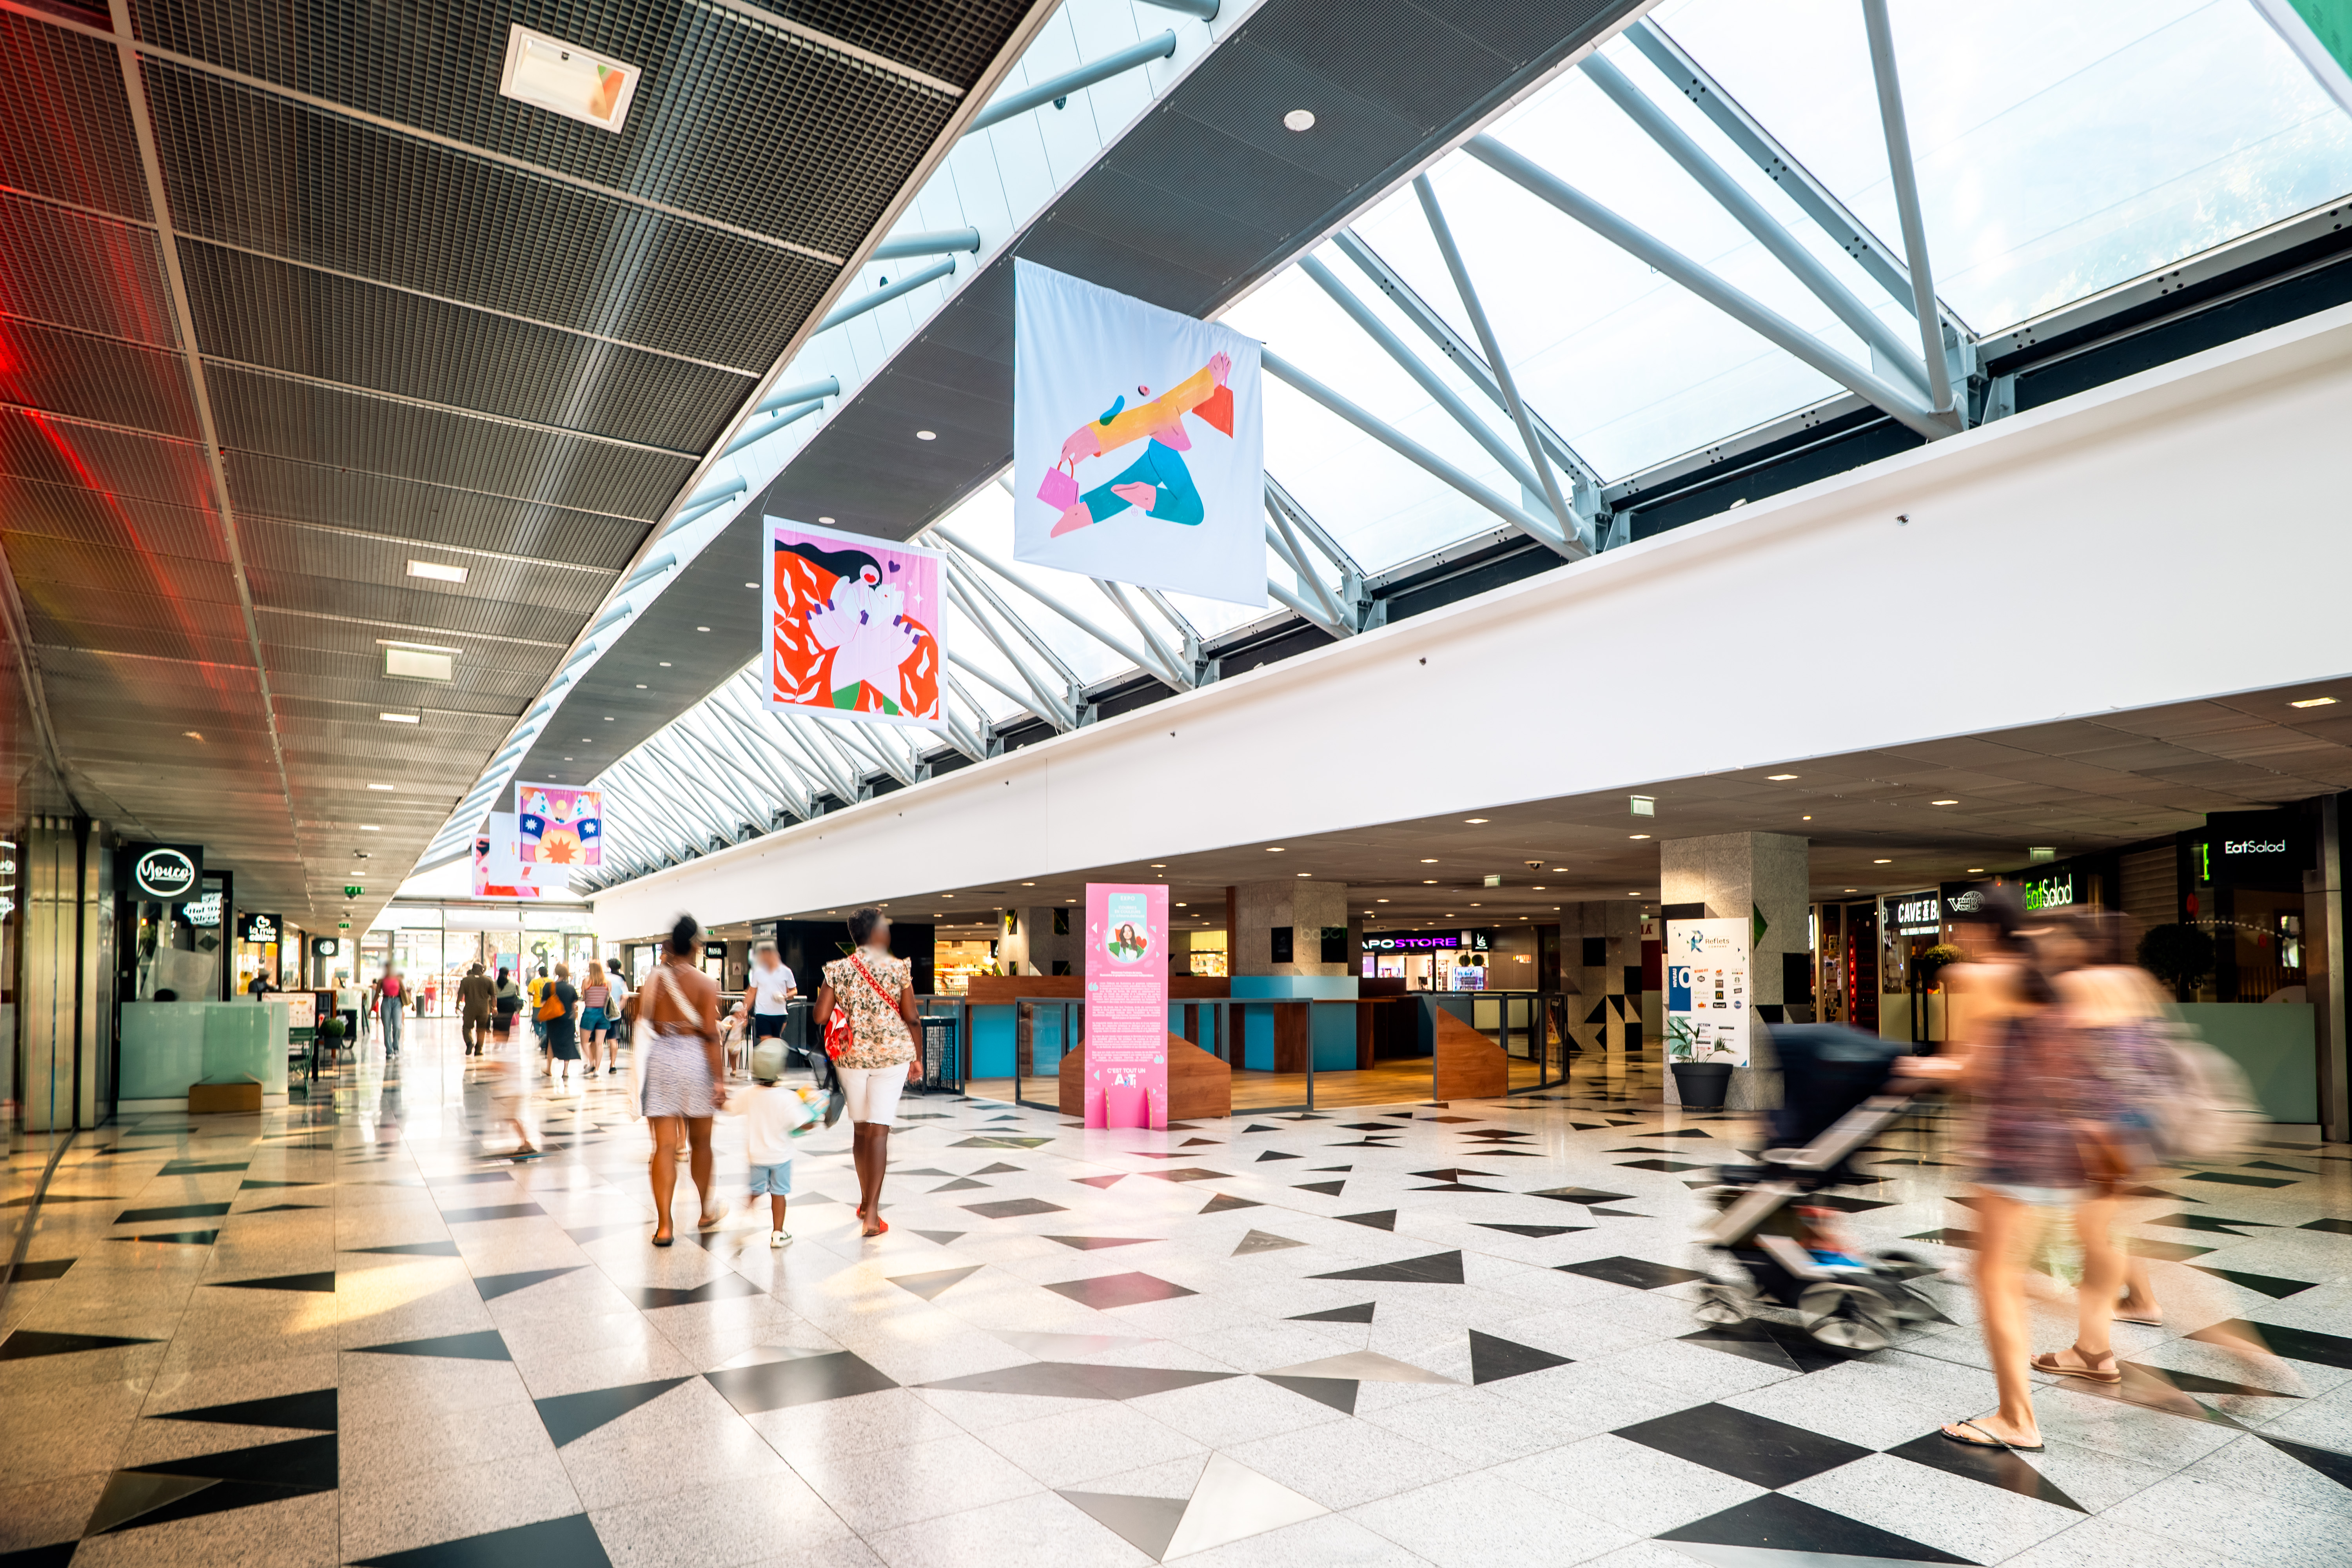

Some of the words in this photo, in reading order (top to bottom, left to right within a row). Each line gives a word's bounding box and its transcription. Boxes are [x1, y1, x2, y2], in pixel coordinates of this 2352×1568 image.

[2225, 839, 2285, 854] EatSalad
[141, 860, 191, 882] Youco
[2025, 873, 2073, 911] EatSalad
[1898, 902, 1922, 923] CAVE
[1922, 900, 1929, 921] &
[249, 925, 258, 934] la
[260, 926, 276, 935] mie
